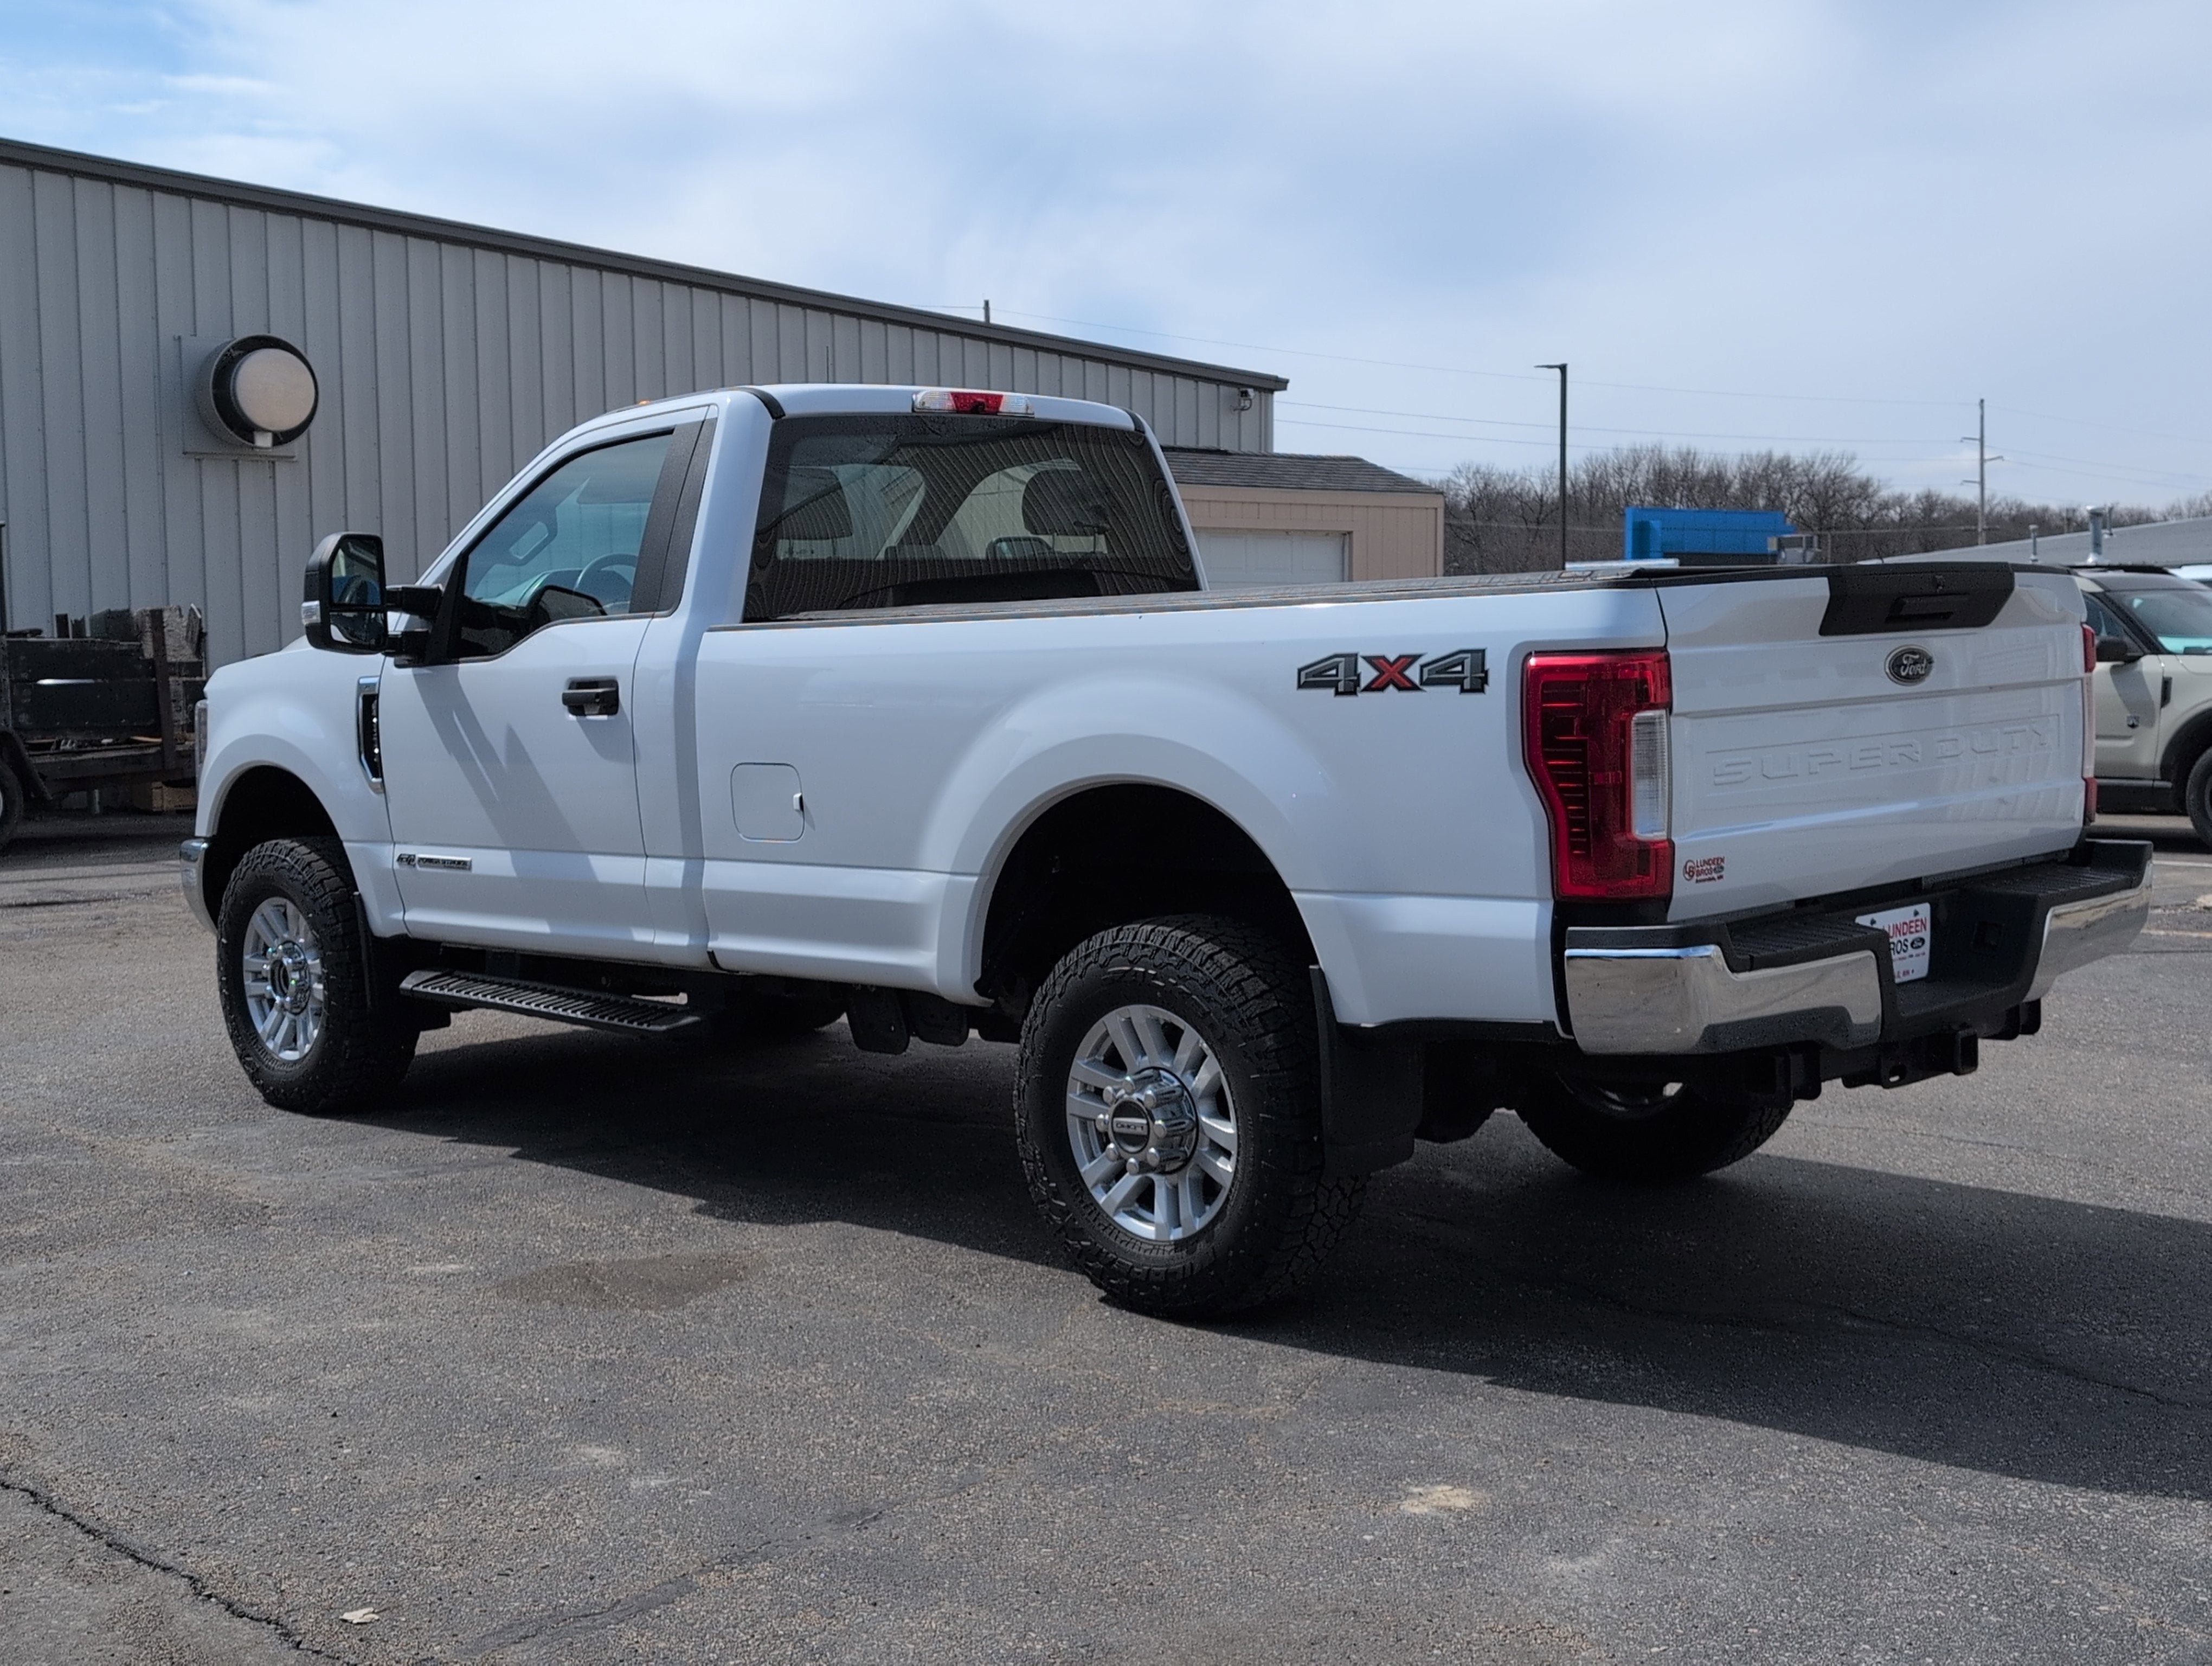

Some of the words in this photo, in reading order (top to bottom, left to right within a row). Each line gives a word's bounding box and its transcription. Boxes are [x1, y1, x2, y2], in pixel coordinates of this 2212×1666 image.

[1900, 653, 1927, 676] Ford
[1713, 742, 1920, 786] SUPER
[1935, 727, 2055, 759] DUTY
[1696, 856, 1725, 868] LUNDEEN
[1696, 867, 1713, 877] BROS
[1889, 938, 1909, 956] ROS
